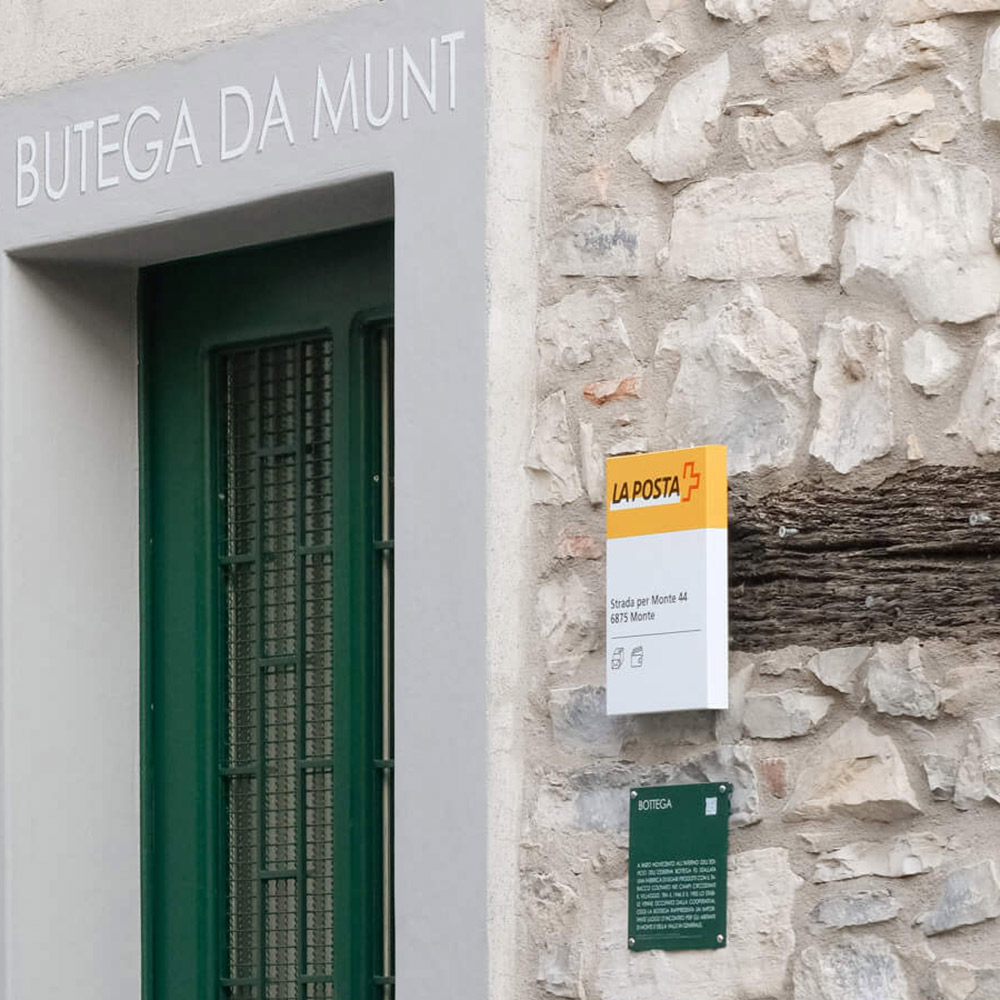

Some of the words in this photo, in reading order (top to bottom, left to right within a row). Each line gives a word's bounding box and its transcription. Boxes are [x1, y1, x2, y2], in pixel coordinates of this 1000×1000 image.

[15, 98, 202, 208] BUTEGA
[220, 75, 295, 162] DA
[312, 31, 466, 141] MUNT
[612, 482, 629, 504] LA
[632, 475, 680, 502] POSTA
[610, 597, 635, 610] Strada
[637, 598, 649, 609] per
[651, 594, 677, 605] Monte
[678, 592, 688, 601] 44
[610, 612, 629, 624] 6875
[630, 611, 656, 622] Monte
[638, 798, 672, 811] BOTTEGA
